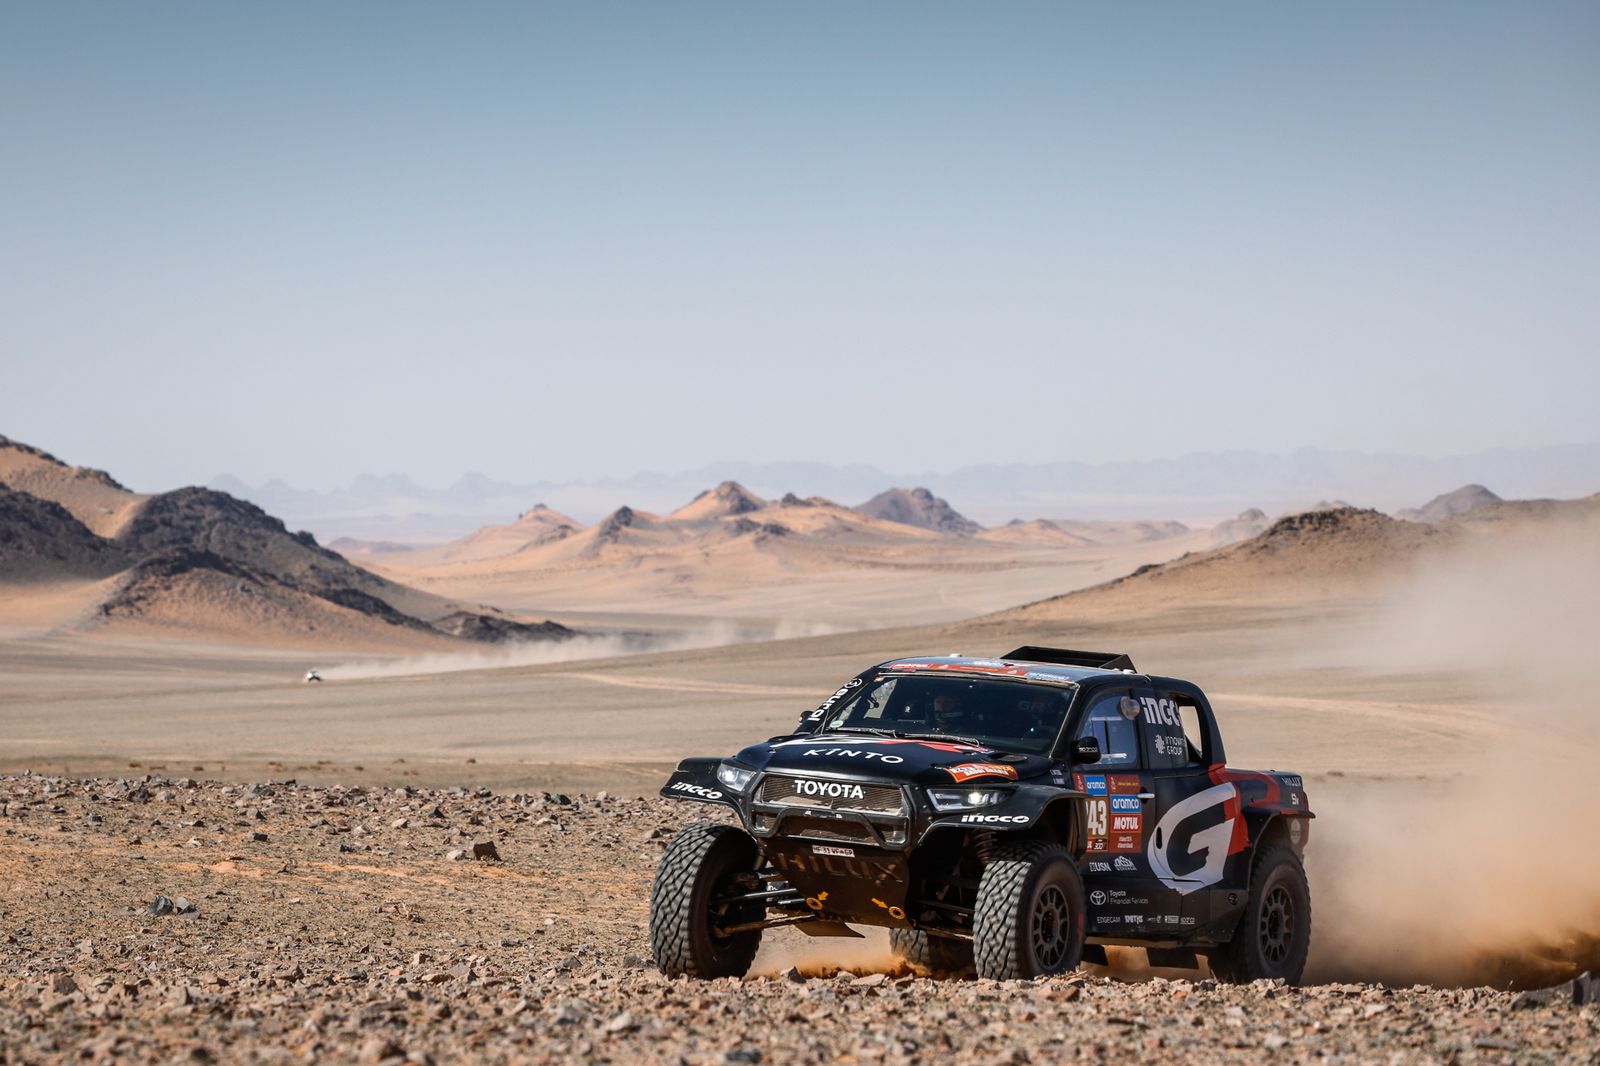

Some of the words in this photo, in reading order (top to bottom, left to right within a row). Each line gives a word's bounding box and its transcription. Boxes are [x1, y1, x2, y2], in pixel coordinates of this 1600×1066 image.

[802, 748, 905, 764] KINTO
[794, 779, 864, 799] TOYOTA
[1086, 780, 1106, 790] aramco
[1112, 798, 1140, 809] aramco
[1086, 800, 1107, 836] 43
[1113, 816, 1139, 830] MOTUL
[1109, 889, 1127, 898] Toyota
